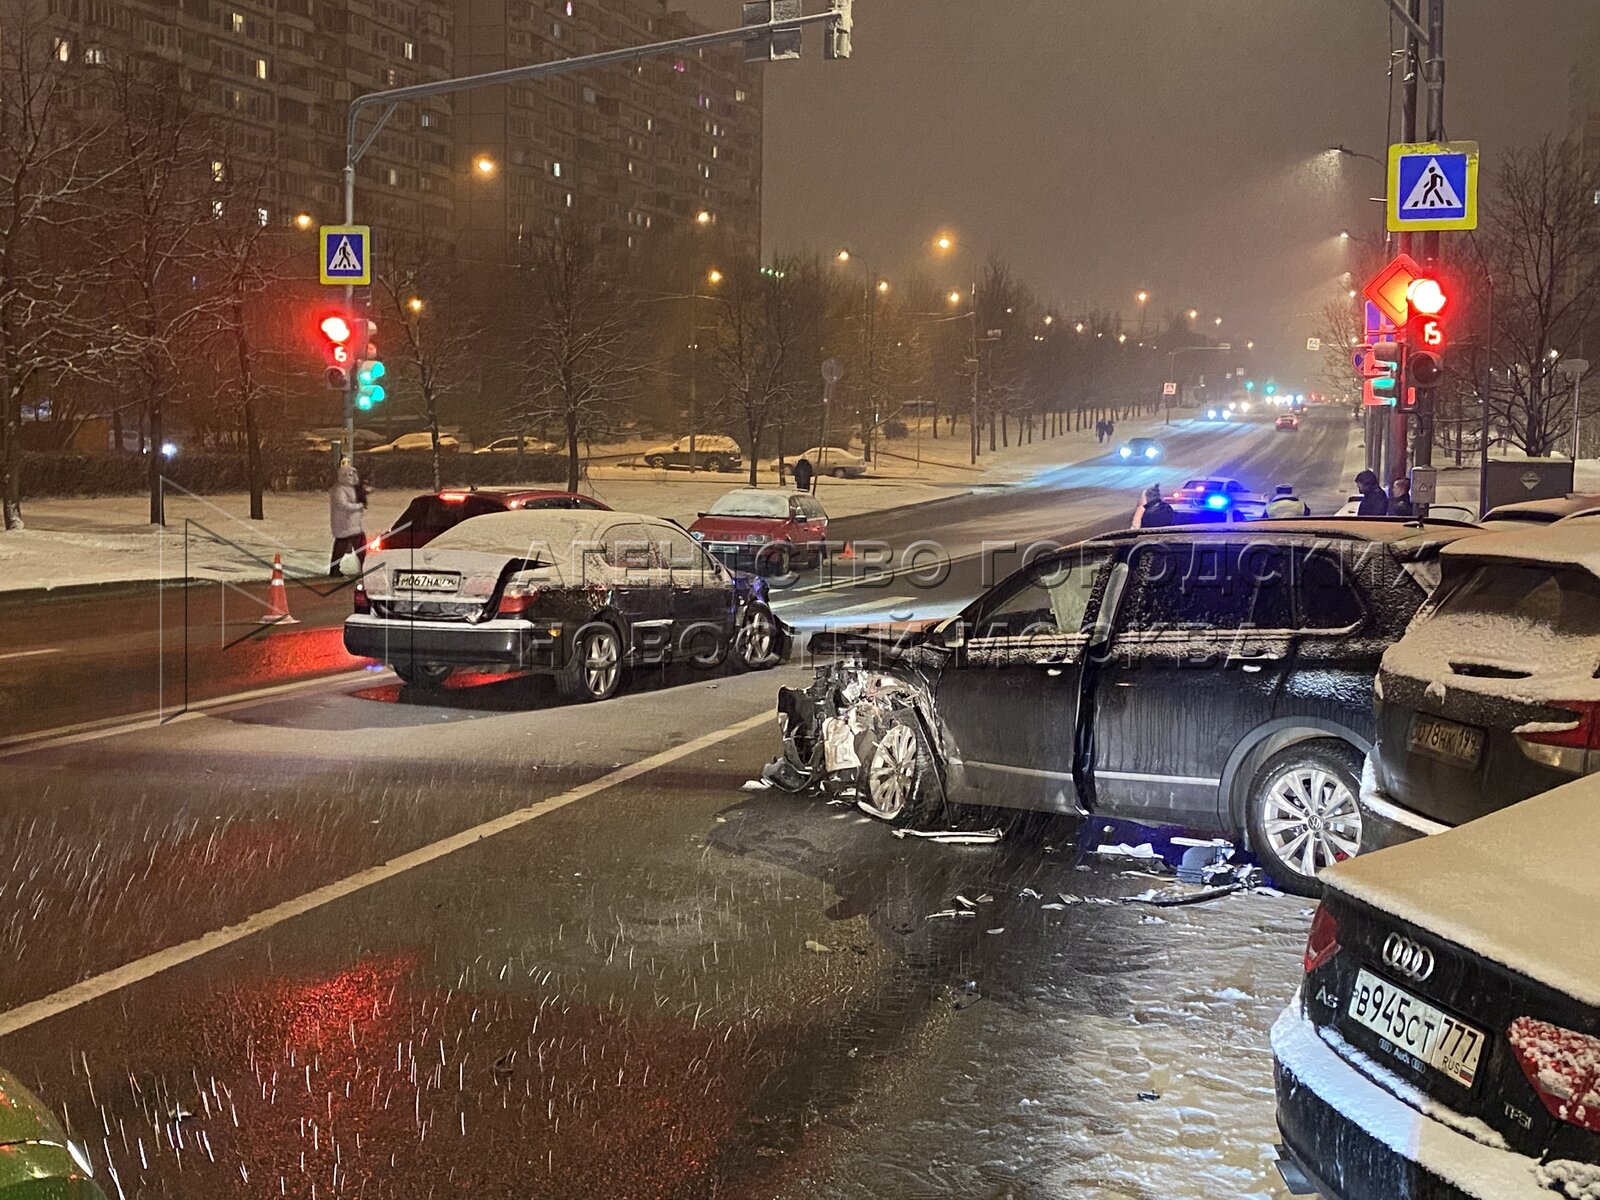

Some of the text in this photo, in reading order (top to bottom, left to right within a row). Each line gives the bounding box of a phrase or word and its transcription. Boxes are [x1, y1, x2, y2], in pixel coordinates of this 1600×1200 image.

[333, 346, 347, 362] 6
[1356, 984, 1478, 1064] В945СТ 777
[1441, 1055, 1461, 1076] RUS
[1503, 1101, 1532, 1130] TFSI
